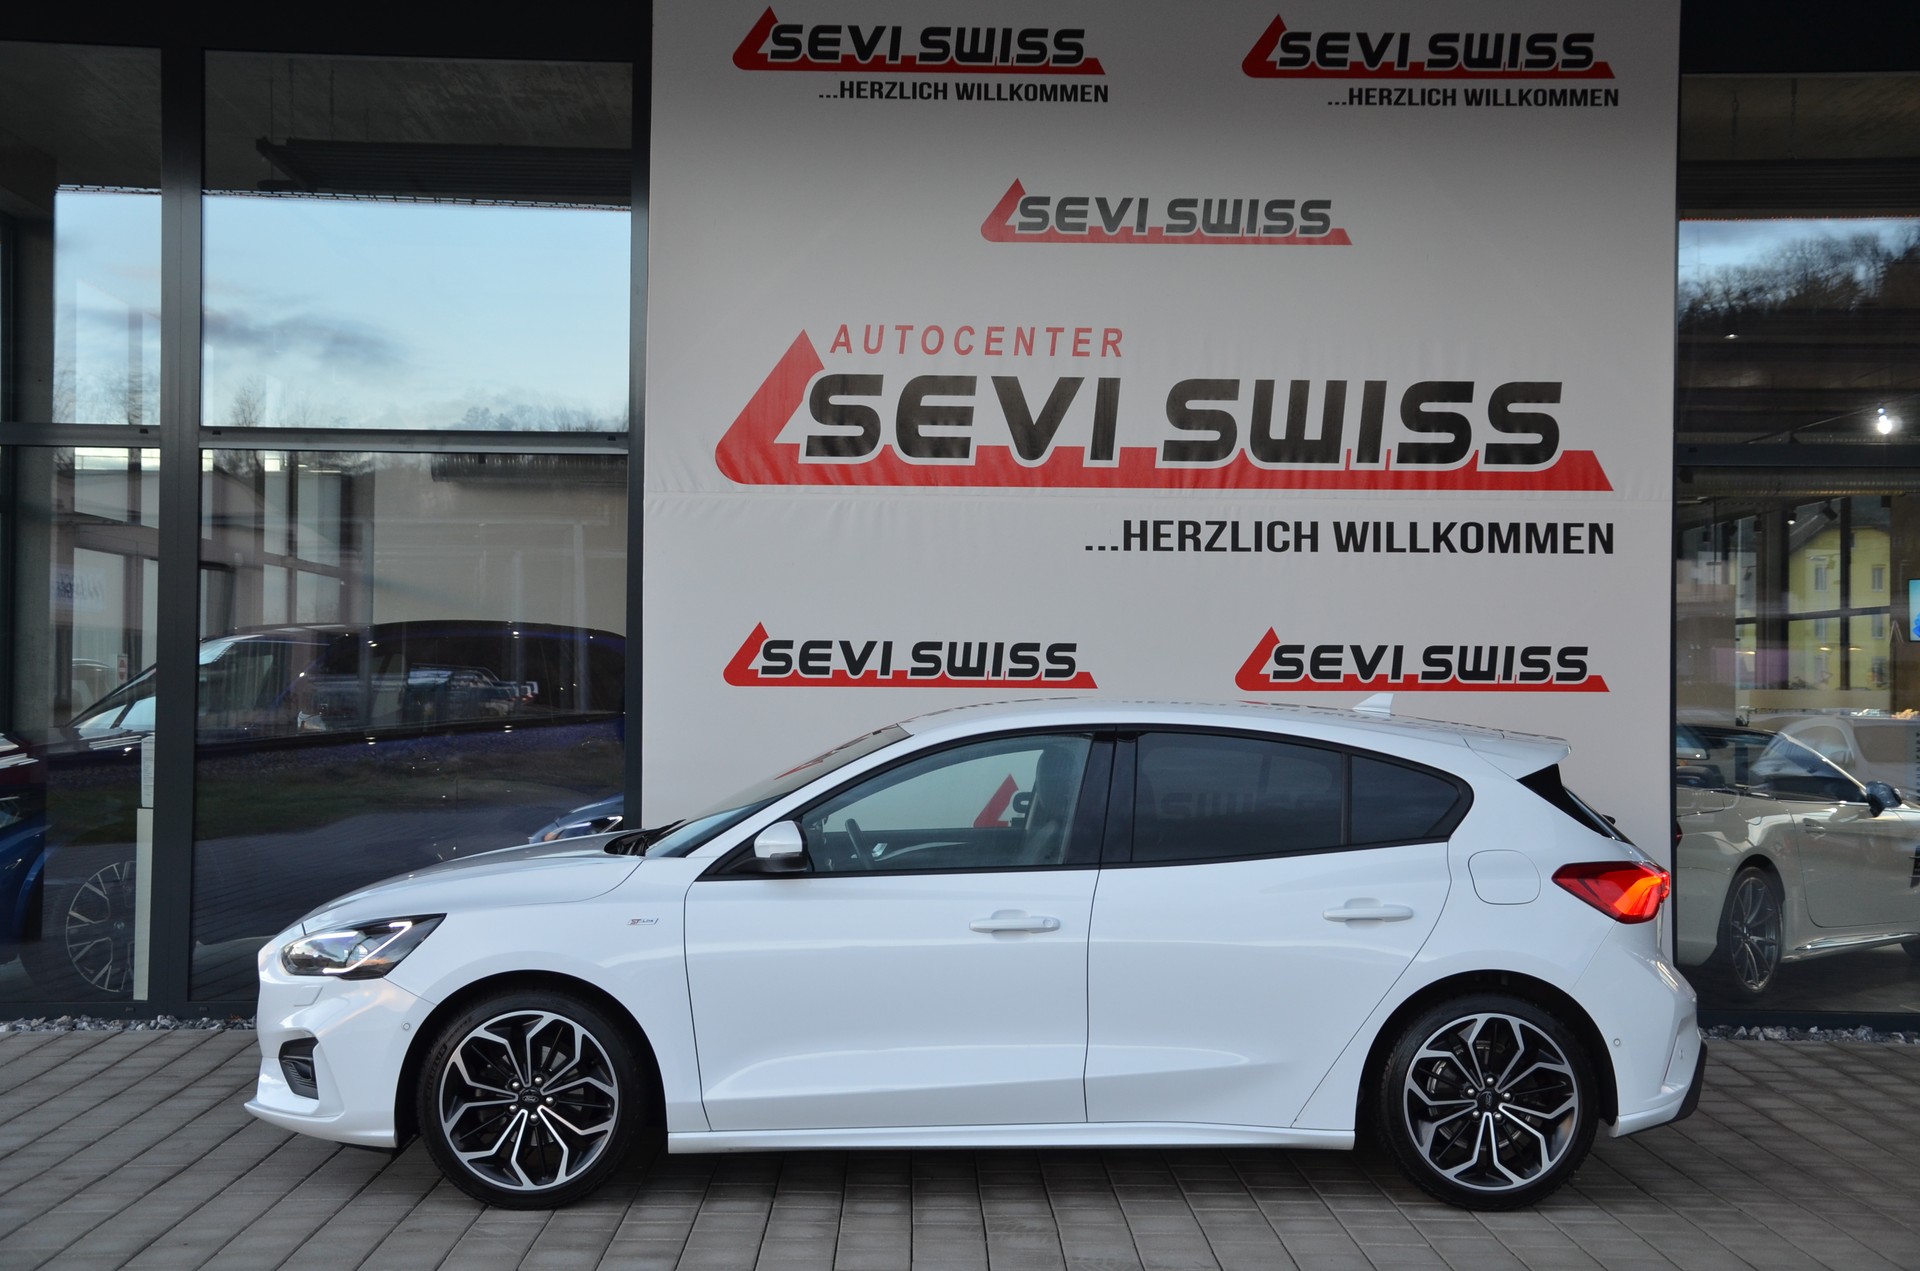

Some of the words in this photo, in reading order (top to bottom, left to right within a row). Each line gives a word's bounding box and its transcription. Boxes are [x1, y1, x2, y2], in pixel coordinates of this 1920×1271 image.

[769, 24, 902, 63] SEVI
[918, 26, 1085, 65] SWISS
[1277, 31, 1411, 69] SEVI
[1426, 32, 1595, 70] SWISS
[818, 81, 948, 101] ...HERZLICH
[955, 82, 1109, 103] WILLKOMMEN
[1327, 88, 1457, 106] ...HERZLICH
[1464, 88, 1619, 107] WILLKOMMEN
[1018, 196, 1149, 232] SEVI
[1166, 198, 1332, 235] SWISS
[830, 324, 1124, 358] AUTOCENTER
[806, 374, 1121, 460] SEVI
[1163, 379, 1562, 466] SWISS
[1085, 520, 1319, 553] ...HERZLICH
[1333, 522, 1614, 555] WILLKOMMEN
[761, 640, 893, 676] SEVI
[910, 642, 1077, 678] SWISS
[1273, 645, 1403, 680] SEVI
[1421, 646, 1588, 681] SWISS
